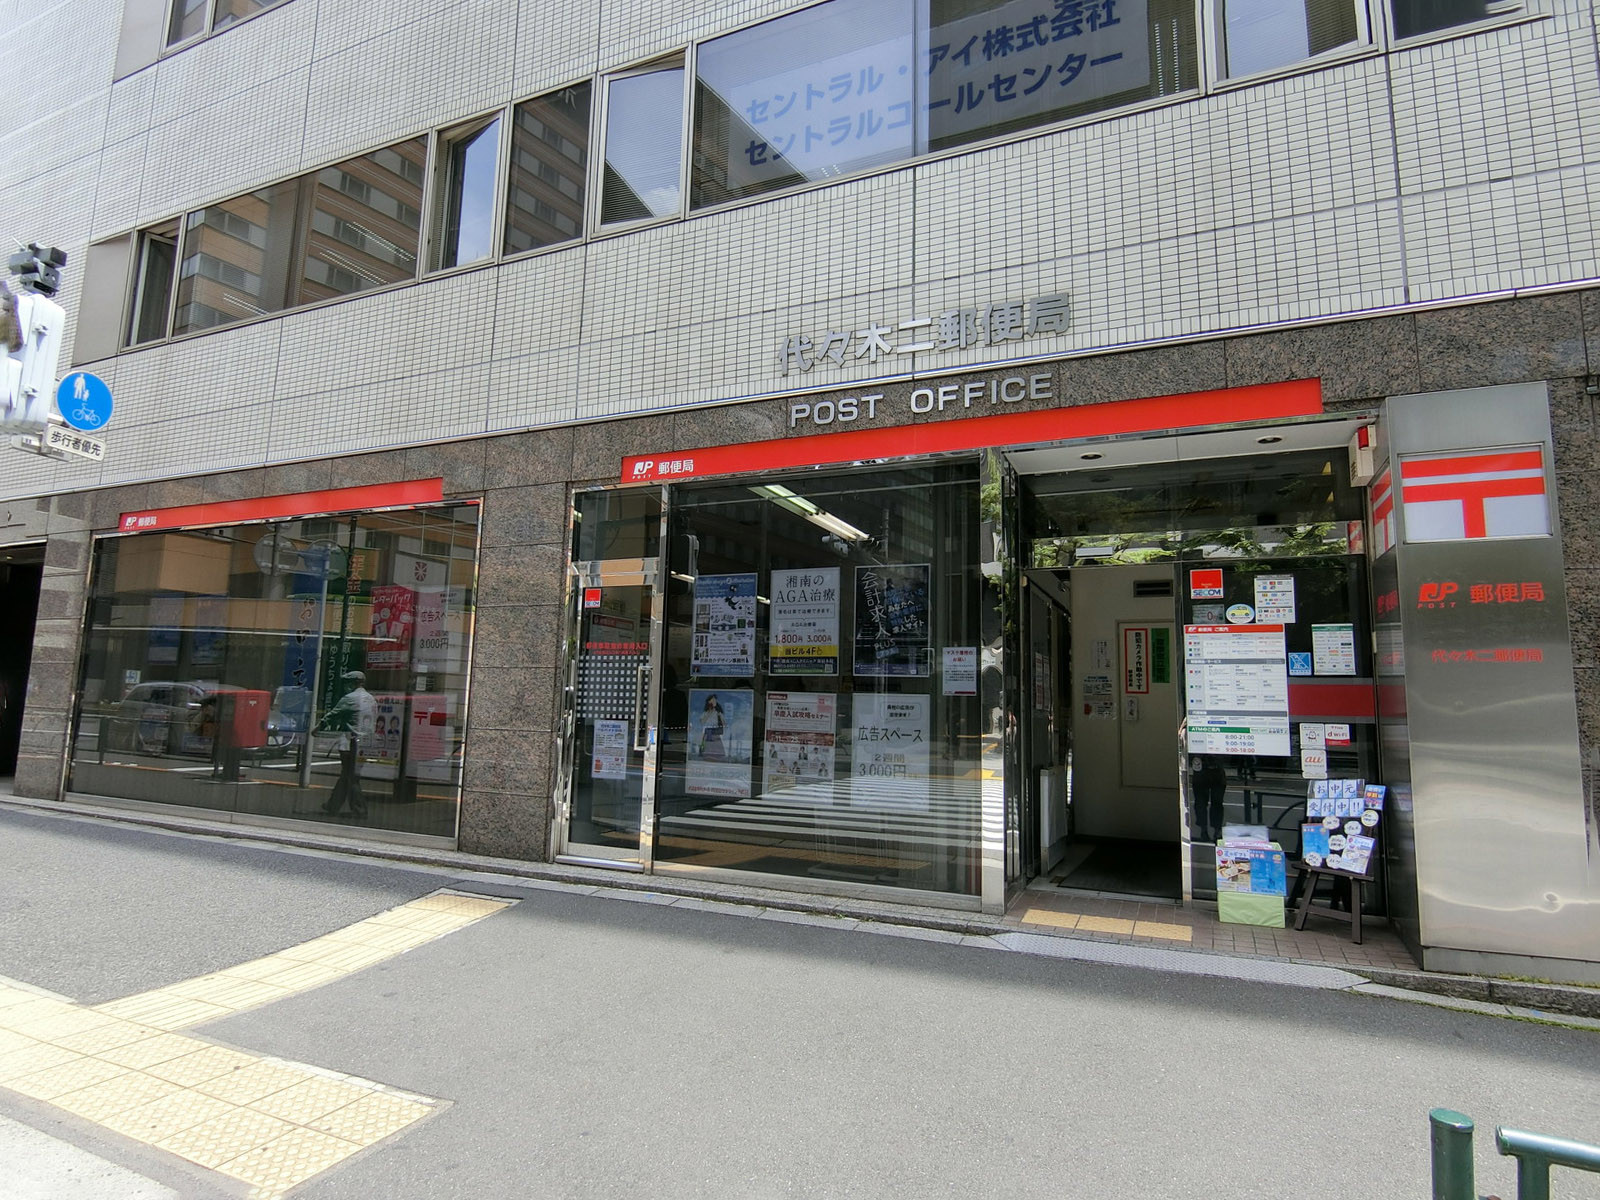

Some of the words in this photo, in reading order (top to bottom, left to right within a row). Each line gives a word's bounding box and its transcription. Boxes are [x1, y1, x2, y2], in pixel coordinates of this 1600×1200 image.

[745, 52, 1123, 166] セントラルコールセンター
[778, 292, 1071, 376] 代々木二郵便局
[790, 394, 884, 428] POST
[910, 372, 1053, 415] OFFICE
[50, 429, 102, 457] 歩行者優先
[658, 459, 694, 475] 郵便局
[786, 575, 824, 588] 湘南の
[775, 588, 835, 604] AGA治療
[1470, 582, 1545, 604] 郵便局
[861, 570, 891, 640] 会計求人
[1417, 601, 1457, 609] POST
[1431, 648, 1544, 664] 代々木二郵便局
[858, 725, 923, 743] 広告スペース
[1304, 756, 1323, 764] au
[1316, 784, 1356, 794] お中元
